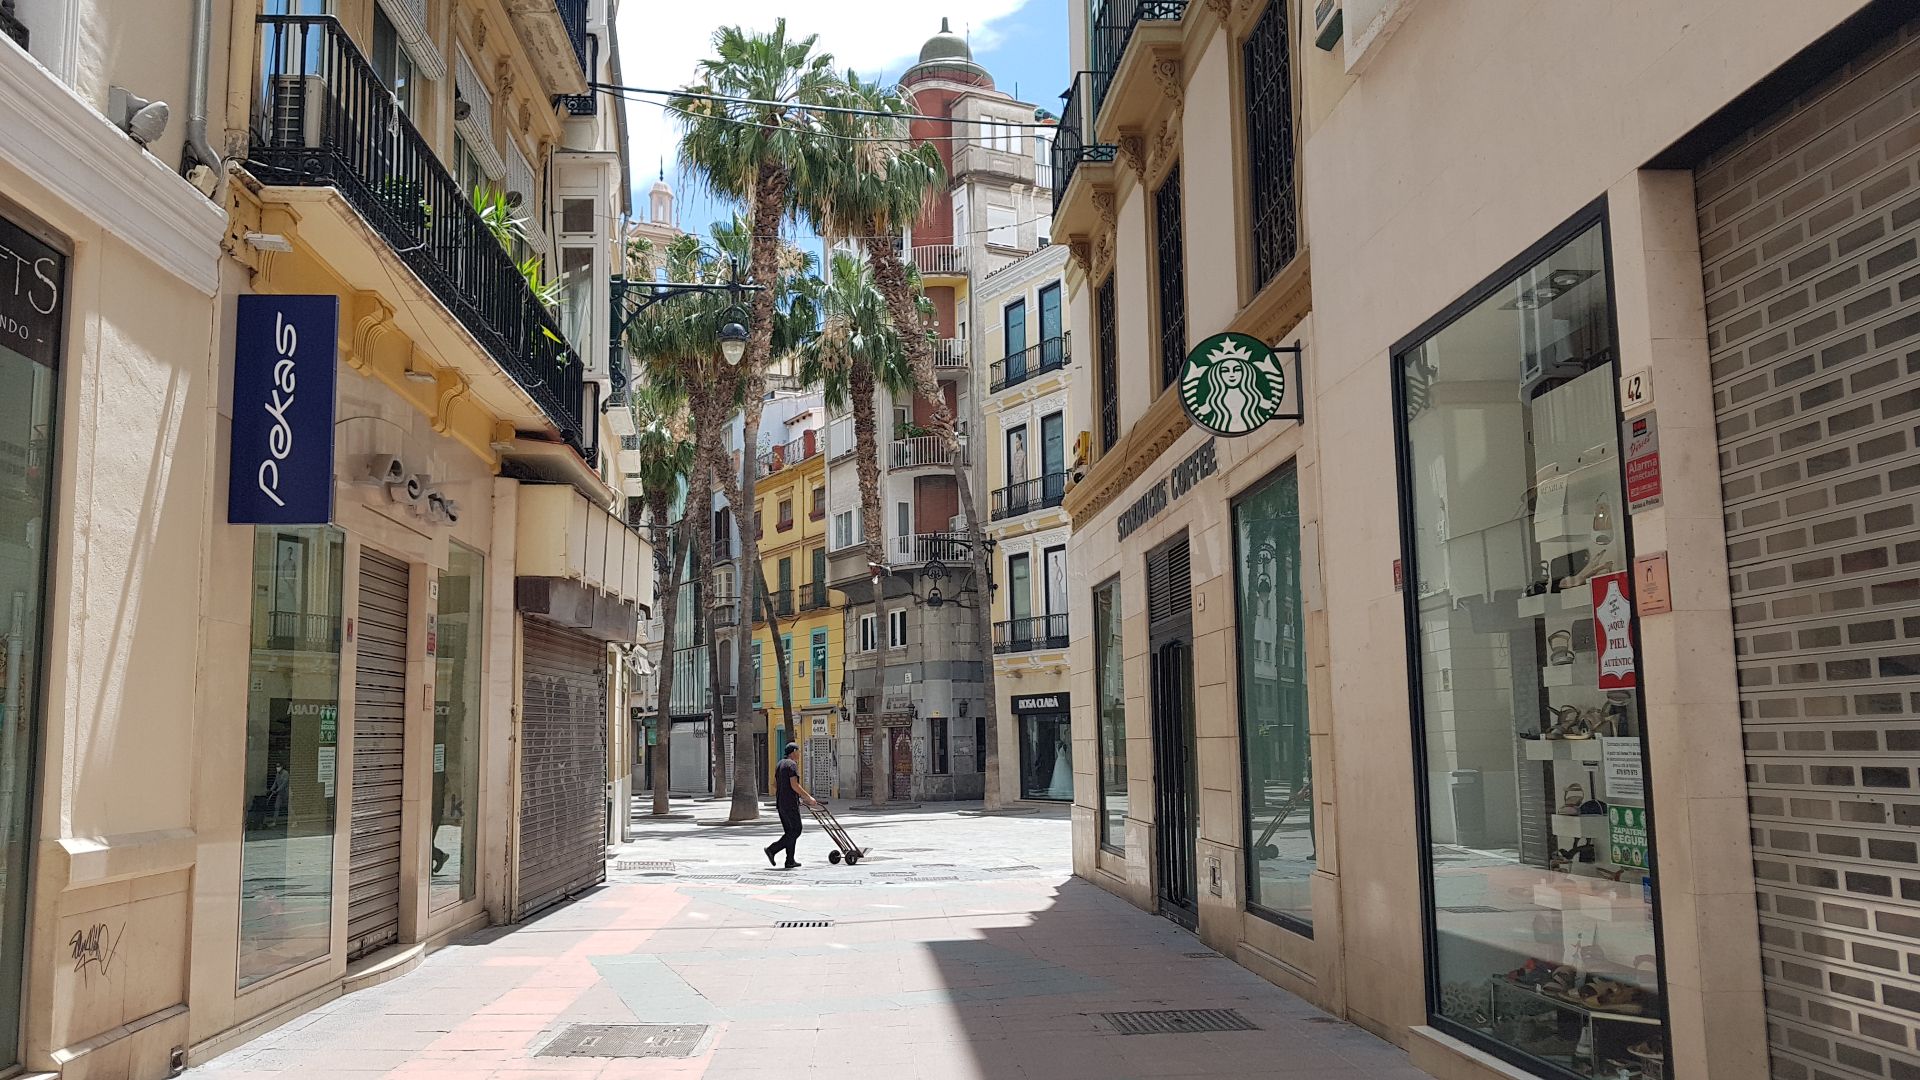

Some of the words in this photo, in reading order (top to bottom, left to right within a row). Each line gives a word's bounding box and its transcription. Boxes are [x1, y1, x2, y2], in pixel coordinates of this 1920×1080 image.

[1628, 376, 1642, 402] 42
[258, 311, 297, 507] pekas
[1171, 436, 1217, 500] COFFEE
[1628, 458, 1657, 475] Alarma
[1628, 468, 1658, 483] conectada
[1609, 637, 1628, 650] PIEL
[1018, 698, 1036, 709] ROSA
[1036, 695, 1059, 708] CLARÁ
